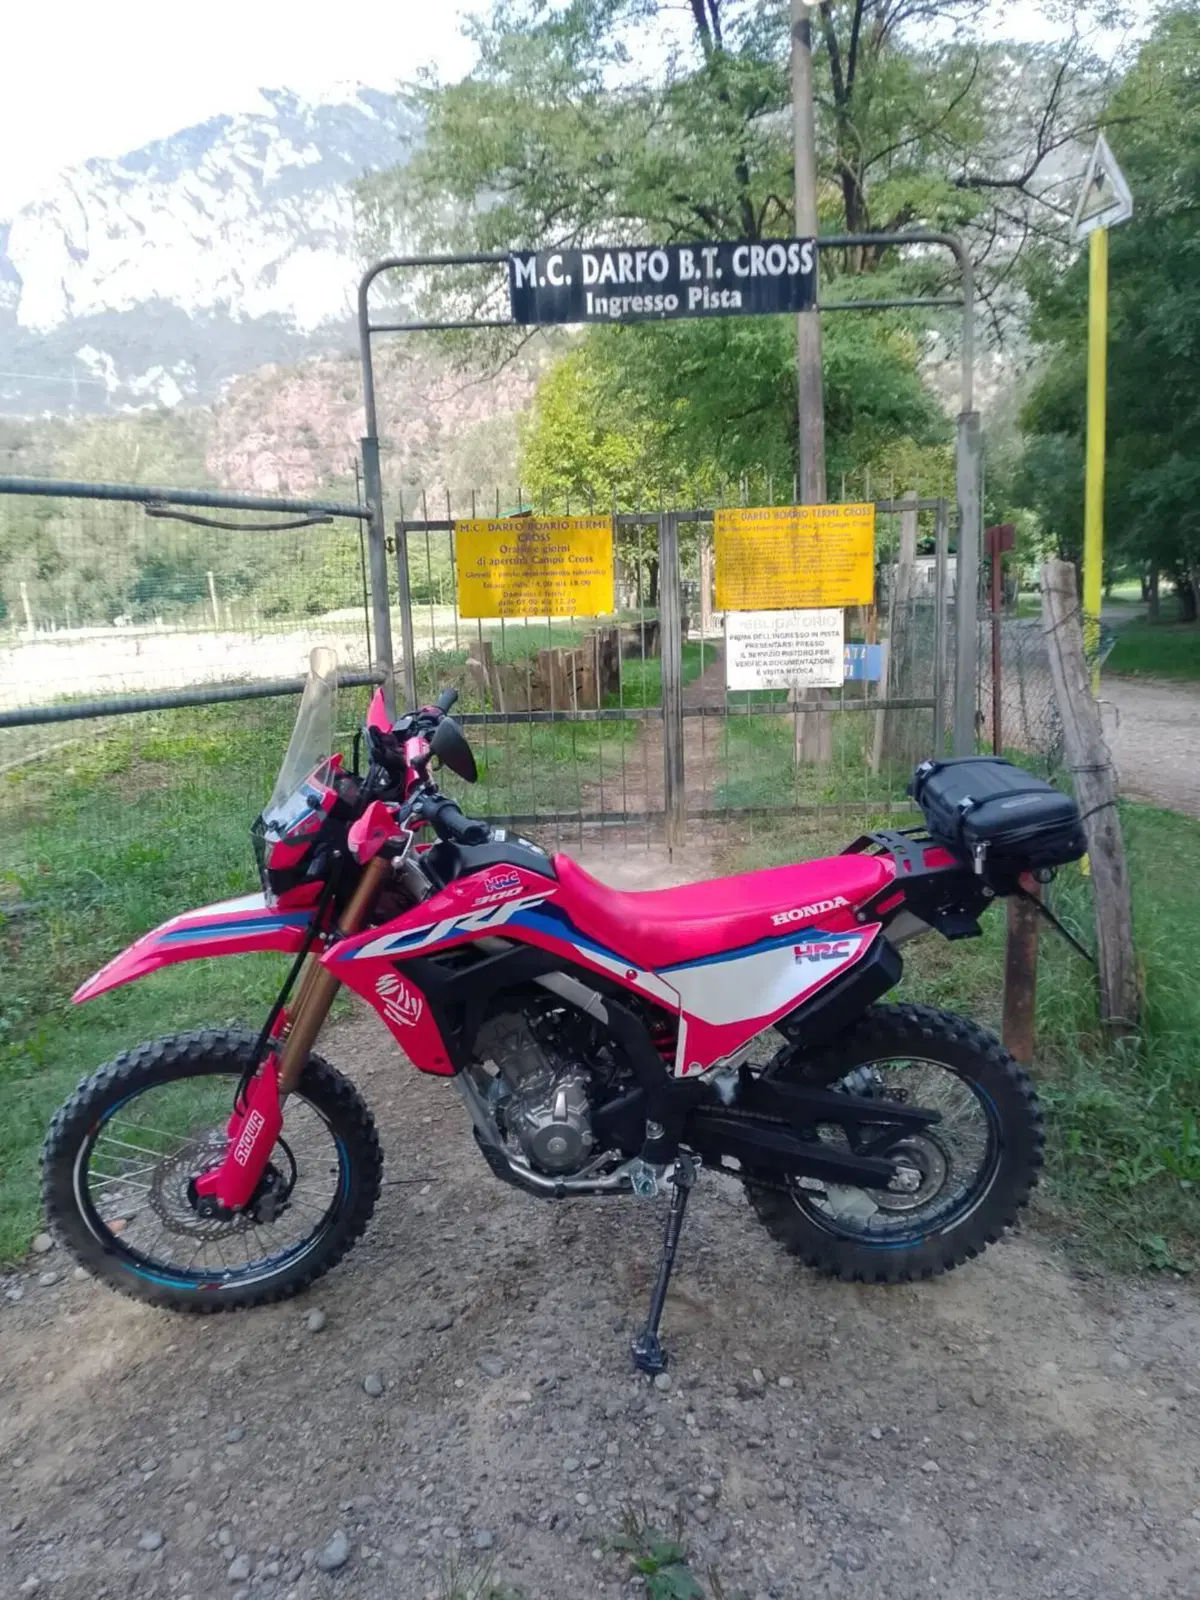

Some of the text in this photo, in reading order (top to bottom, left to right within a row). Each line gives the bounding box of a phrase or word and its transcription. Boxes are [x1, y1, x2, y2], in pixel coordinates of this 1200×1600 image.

[514, 242, 815, 289] M.C. DARFO B.T. CROSS
[586, 285, 743, 318] Ingresso Pista
[476, 555, 487, 567] di
[568, 554, 594, 564] Cross
[795, 640, 825, 648] PRESSO
[820, 630, 841, 639] PISTA
[769, 657, 835, 667] DOCUMENTAZIONE
[815, 648, 830, 656] PER
[786, 666, 814, 675] MEDICA
[484, 870, 521, 893] HRC
[473, 886, 524, 906] 300
[770, 895, 851, 927] HONDA
[793, 941, 850, 965] HRC
[234, 1110, 265, 1167] SHOWA
